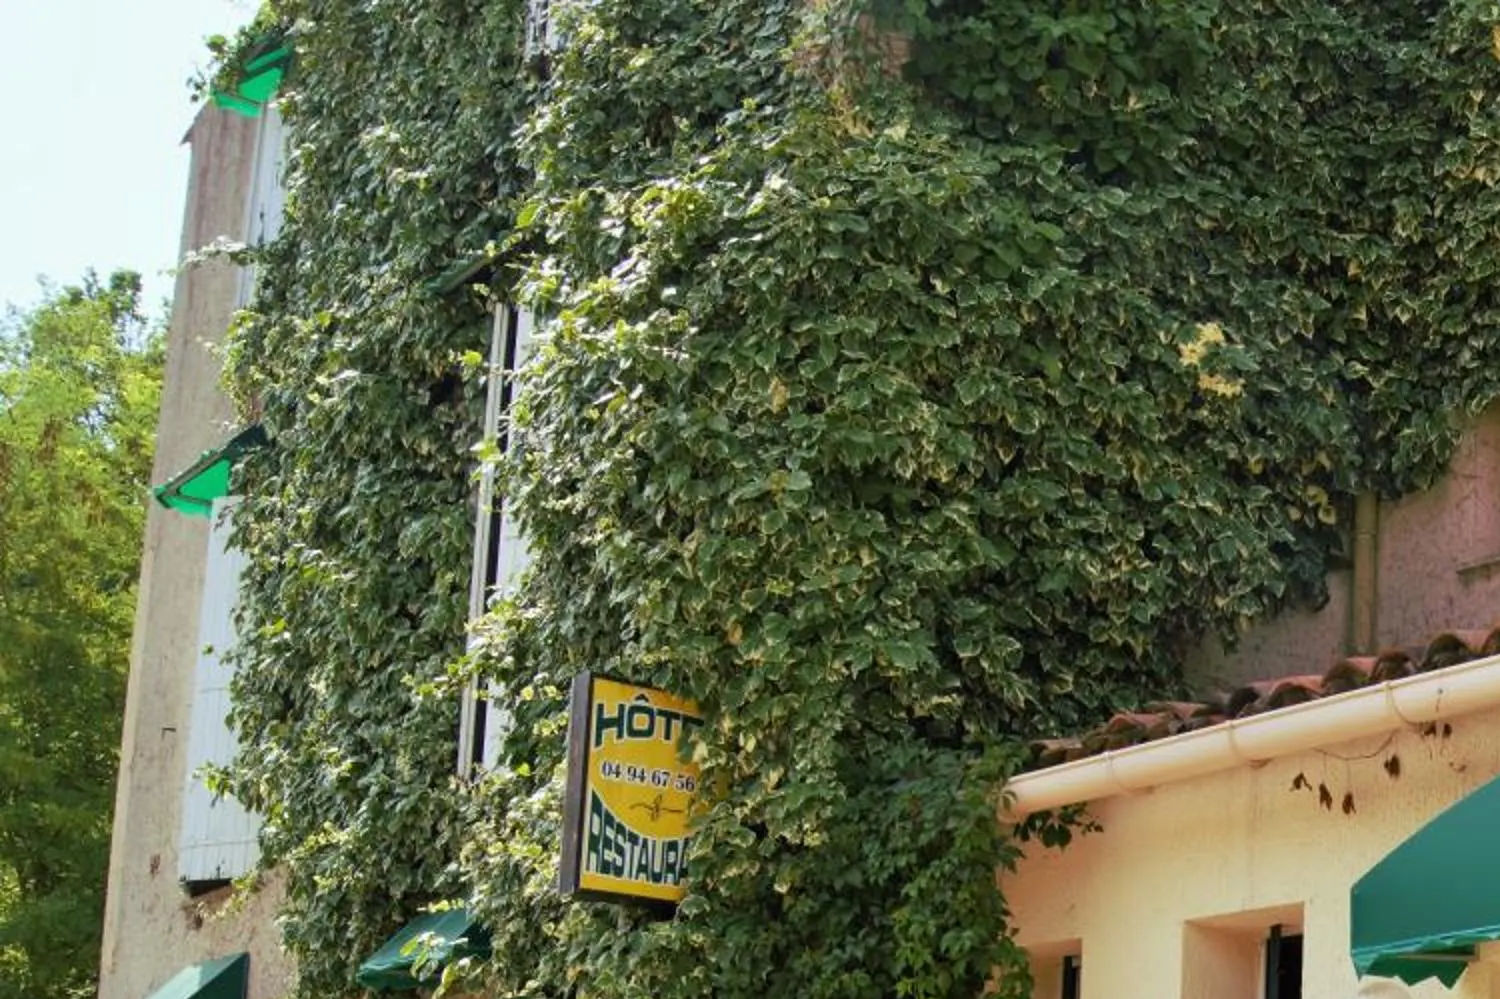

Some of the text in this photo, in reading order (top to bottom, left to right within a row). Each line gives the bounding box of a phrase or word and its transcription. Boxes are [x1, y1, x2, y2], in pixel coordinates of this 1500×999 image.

[602, 760, 696, 793] 04 94 67 56
